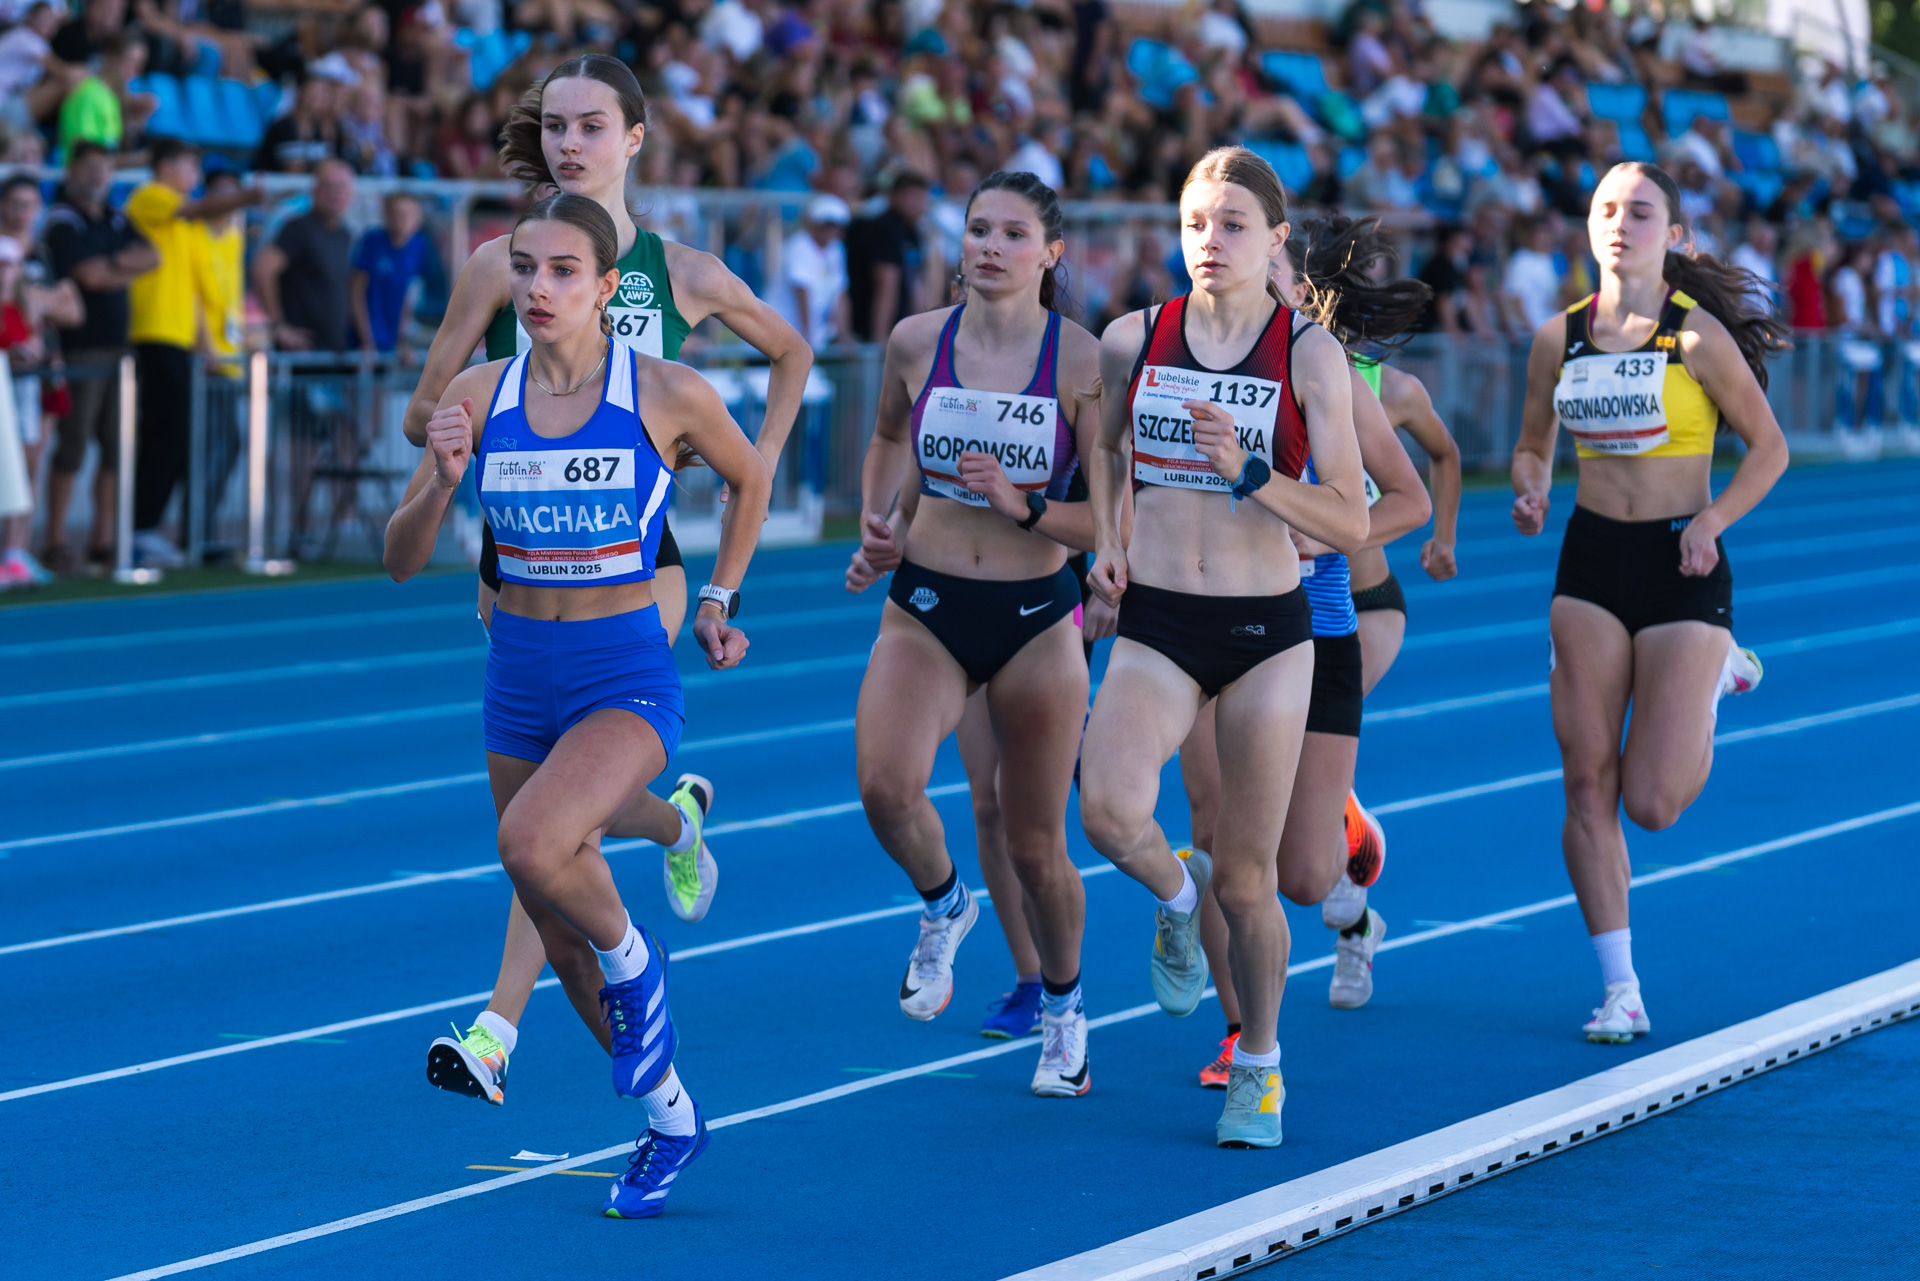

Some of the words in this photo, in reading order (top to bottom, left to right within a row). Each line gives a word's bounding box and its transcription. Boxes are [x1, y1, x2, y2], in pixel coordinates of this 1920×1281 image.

[626, 277, 647, 287] AZS
[625, 290, 650, 301] AWF
[1614, 358, 1655, 378] 433
[1157, 371, 1200, 386] lubelskie
[1209, 380, 1277, 408] 1137
[996, 400, 1045, 425] 746
[1557, 393, 1660, 420] ROZWADOWSKA
[564, 456, 621, 483] 687
[1164, 472, 1203, 484] LUBLIN
[953, 487, 986, 502] LUBLIN
[488, 502, 632, 534] MACHAŁA
[527, 565, 568, 575] LUBLIN
[570, 563, 602, 575] 2025
